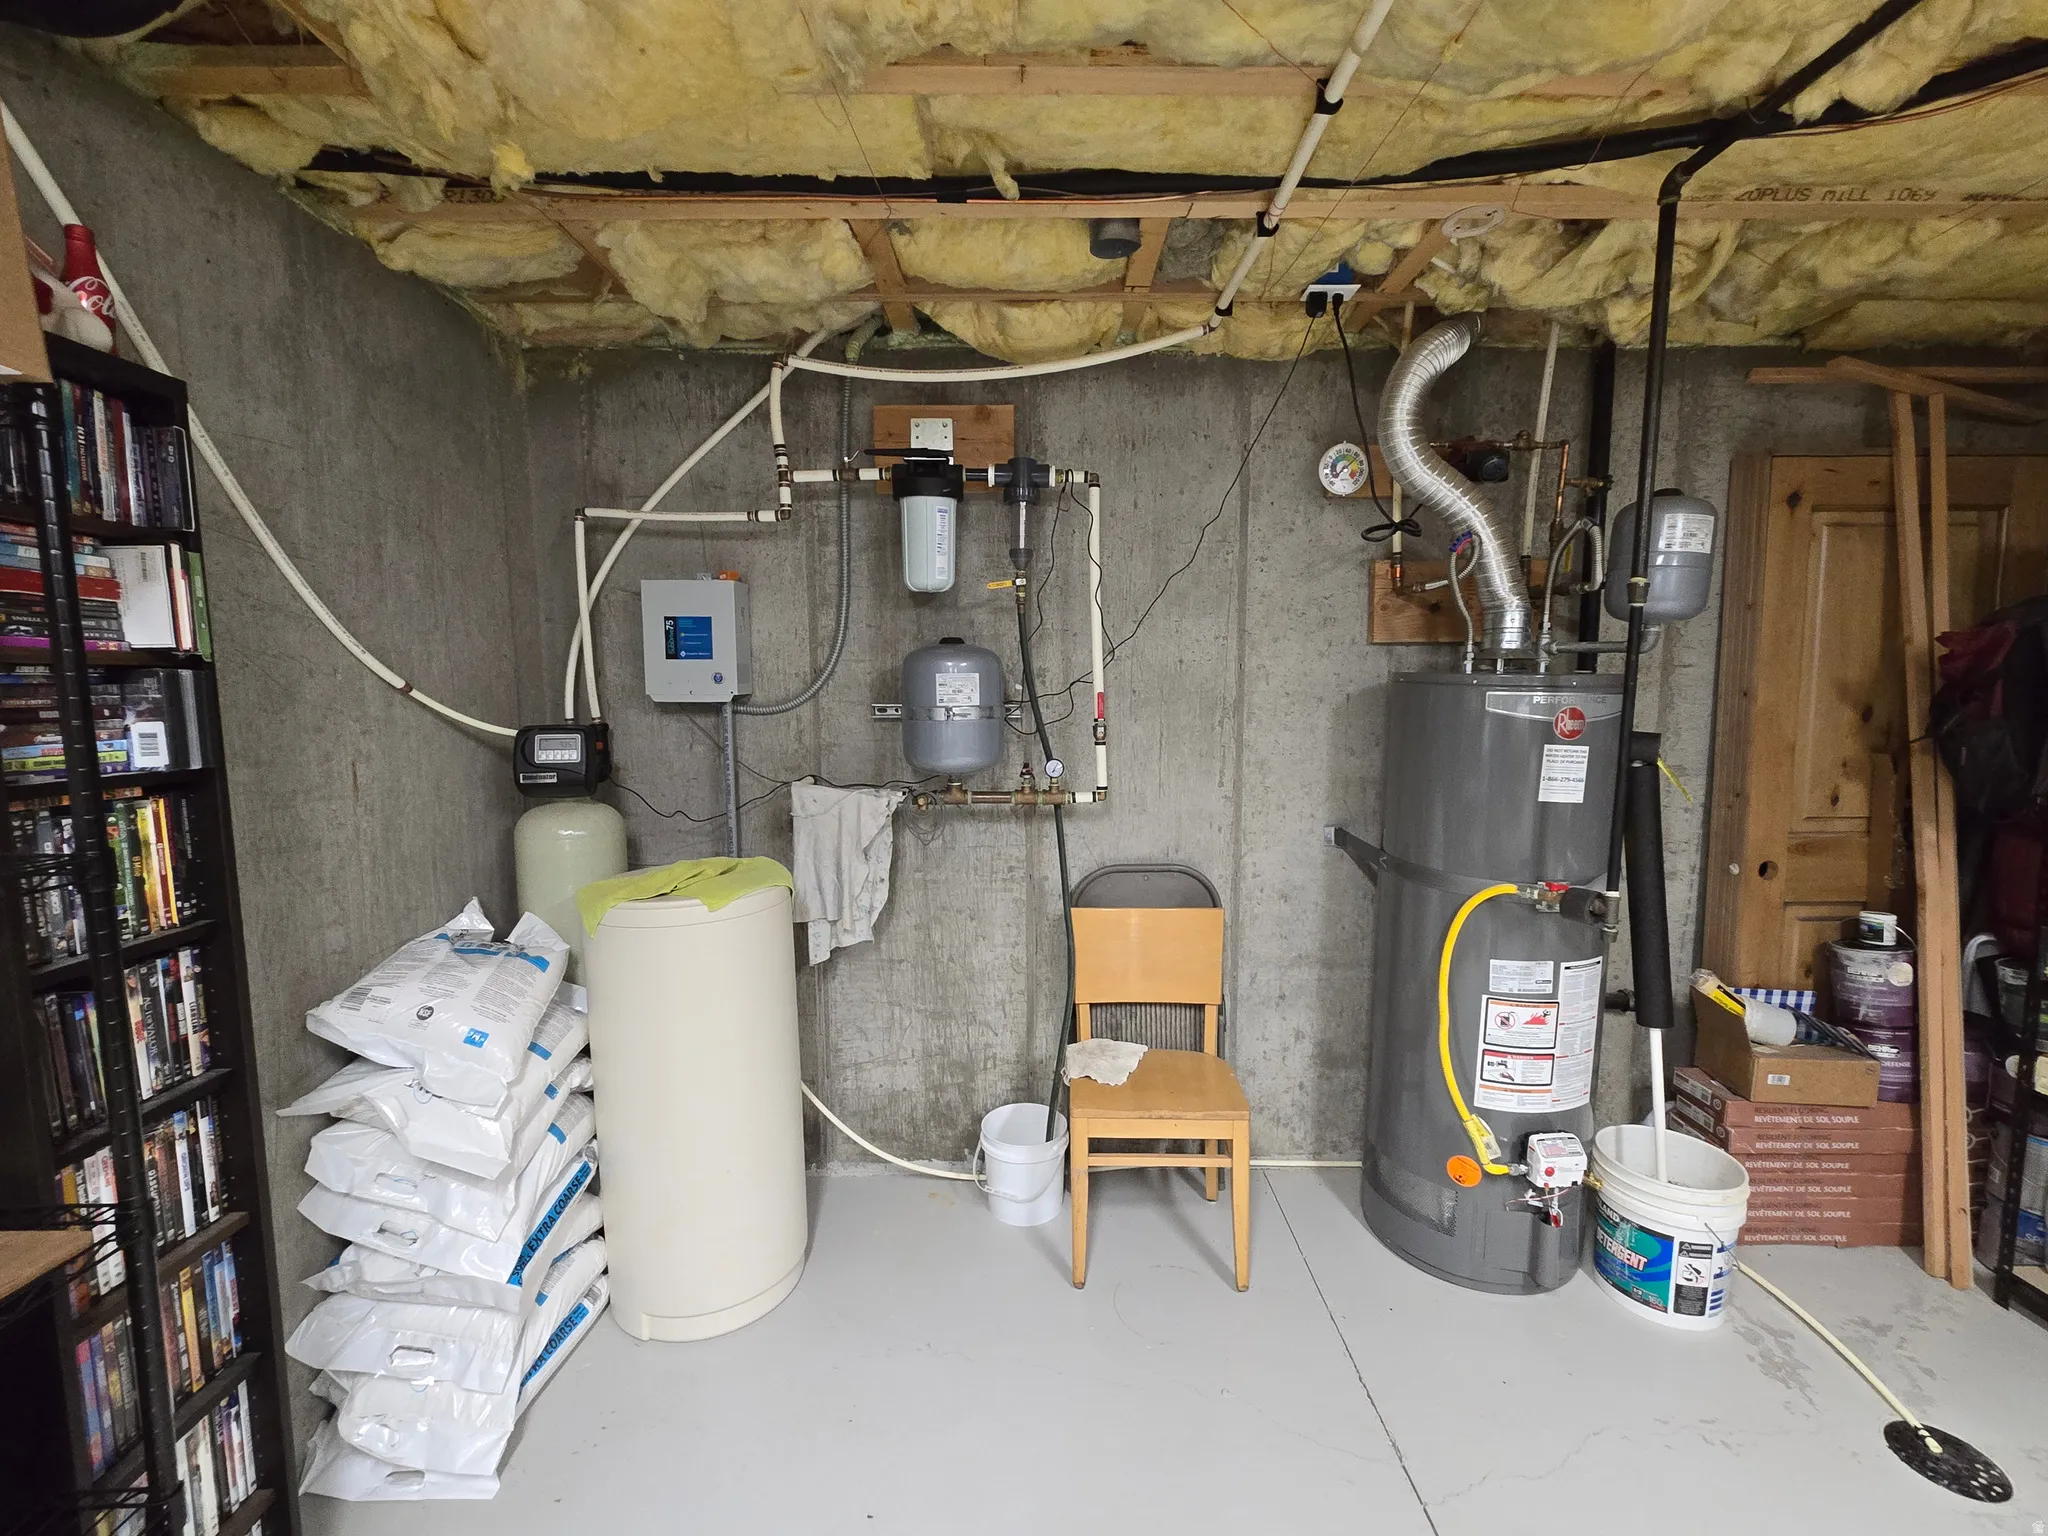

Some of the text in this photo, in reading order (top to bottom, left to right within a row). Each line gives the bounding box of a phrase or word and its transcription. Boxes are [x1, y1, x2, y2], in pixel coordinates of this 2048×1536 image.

[666, 620, 674, 631] 75
[1556, 708, 1585, 735] Rheem
[527, 1174, 583, 1253] EXTRA COARSE
[545, 1315, 578, 1355] COARSE
